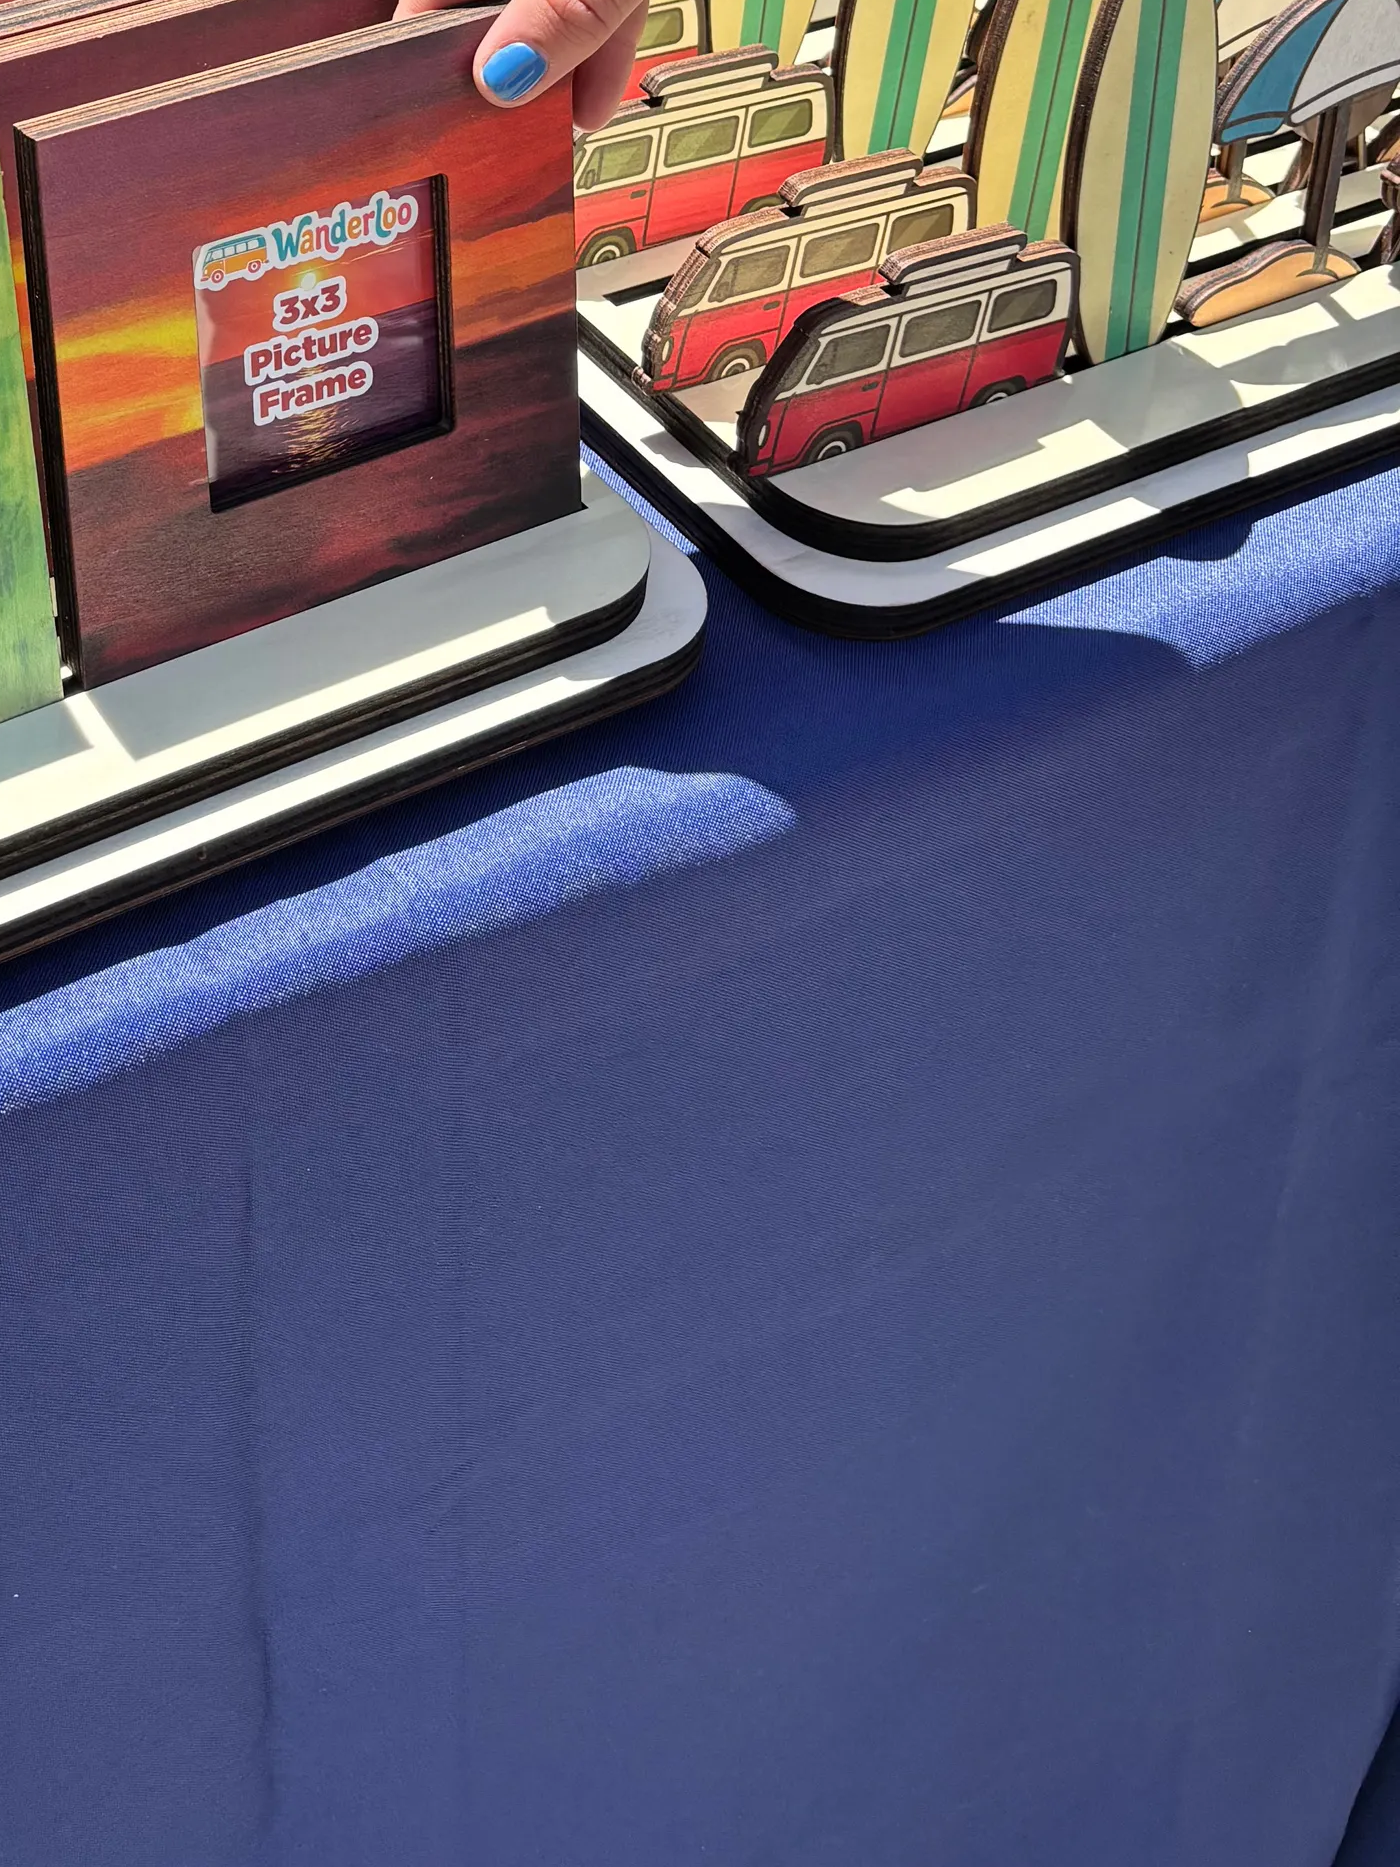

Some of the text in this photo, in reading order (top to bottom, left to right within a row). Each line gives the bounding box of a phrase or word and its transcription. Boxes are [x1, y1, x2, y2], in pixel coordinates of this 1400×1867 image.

[271, 198, 412, 262] Wanderloo
[280, 283, 341, 325] 3x3
[251, 323, 373, 379] Picture
[259, 367, 367, 419] Frame
